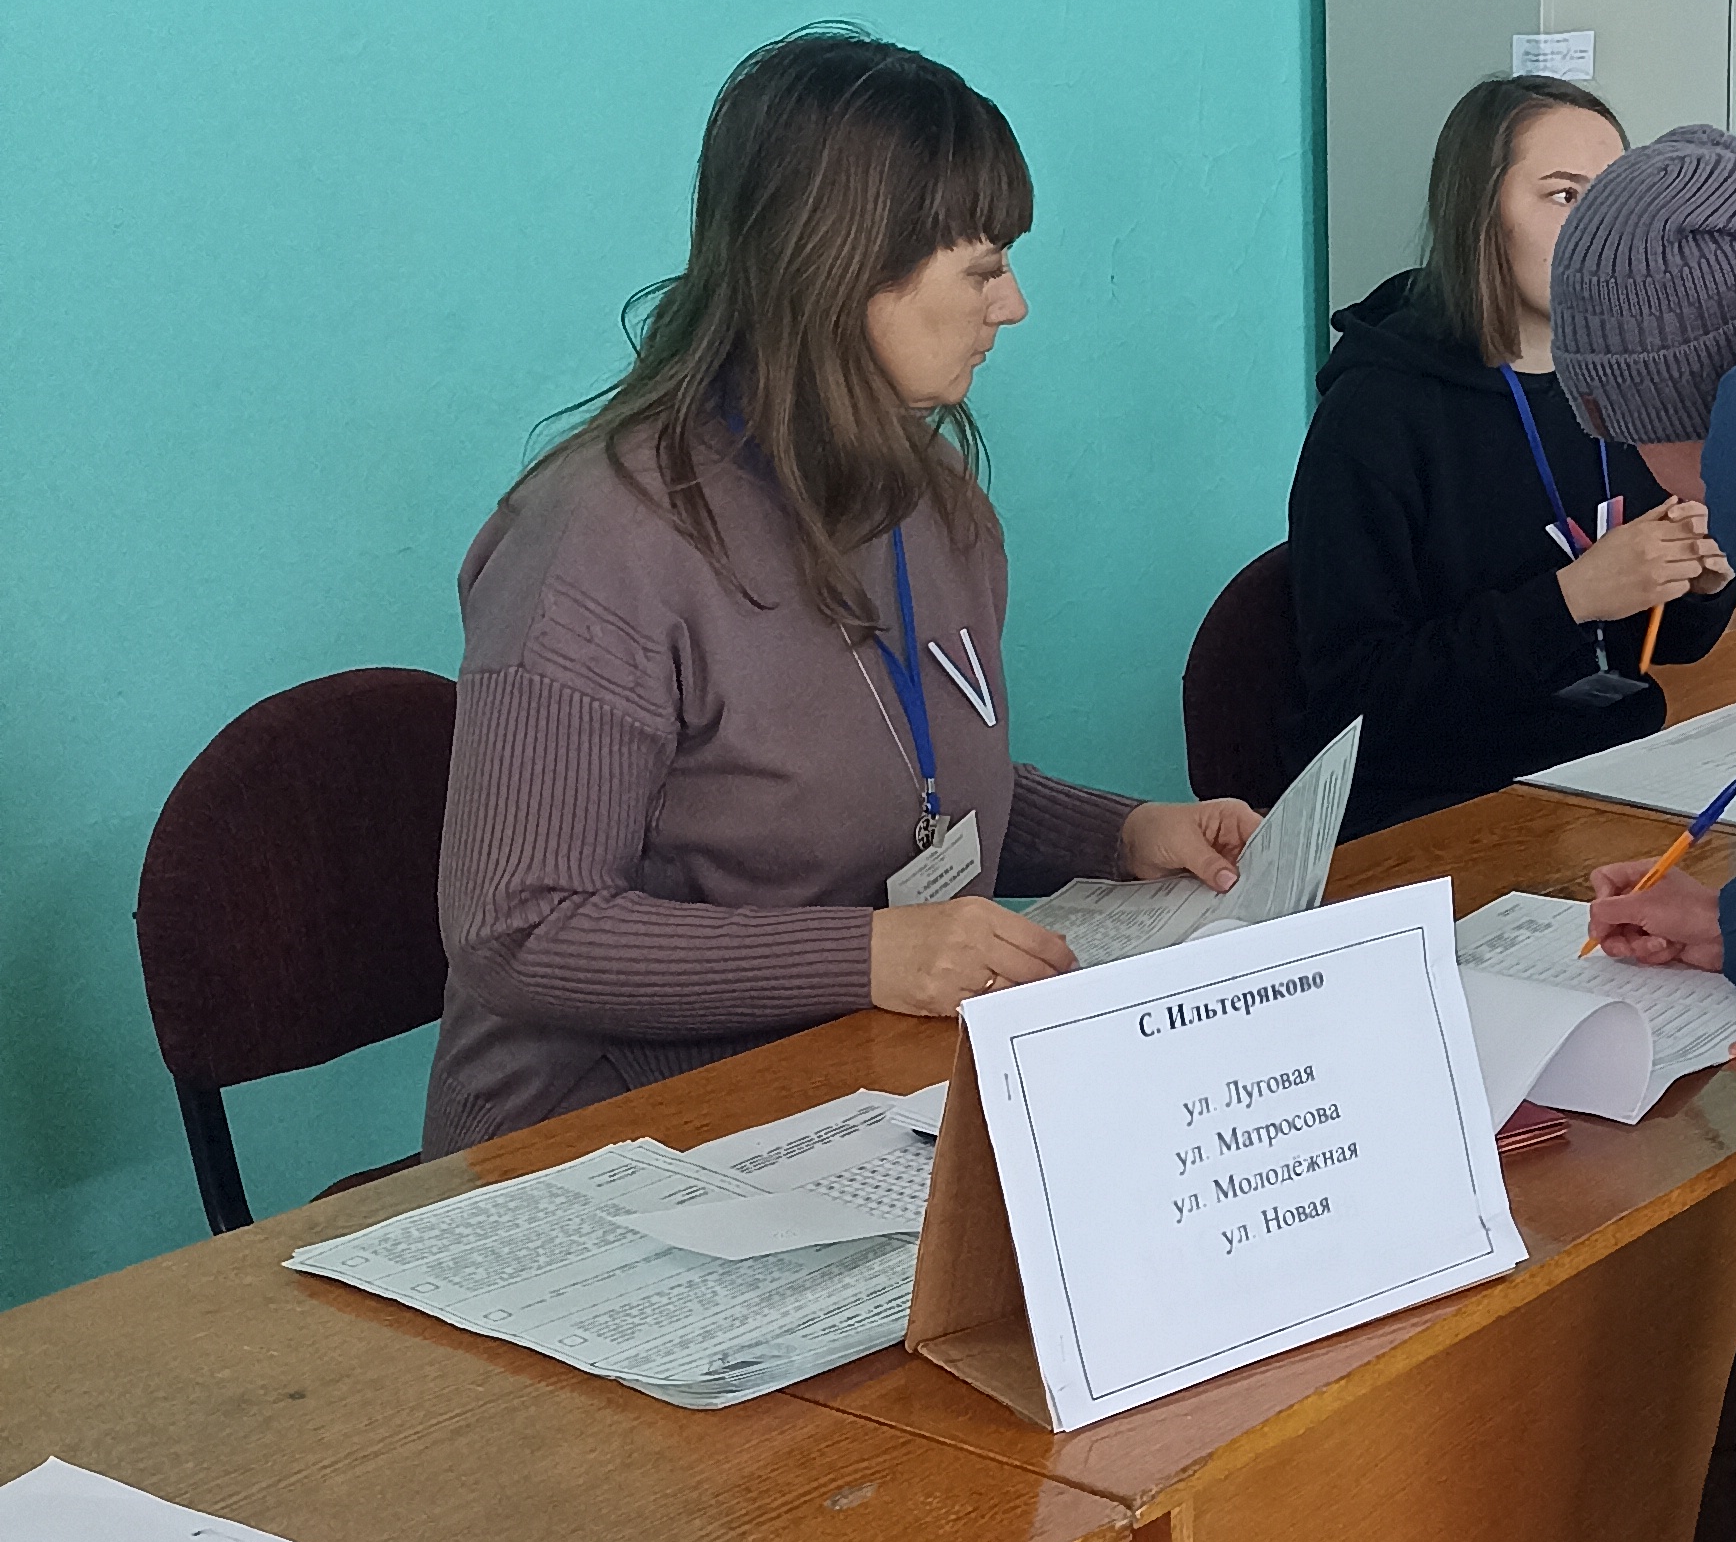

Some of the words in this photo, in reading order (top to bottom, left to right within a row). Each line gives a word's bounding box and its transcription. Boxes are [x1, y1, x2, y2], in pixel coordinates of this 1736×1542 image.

[1138, 1012, 1162, 1038] С.
[1166, 970, 1325, 1031] Ильтеряково
[1182, 1096, 1218, 1128] ул.
[1224, 1064, 1316, 1110] Луговая
[1174, 1145, 1210, 1176] ул.
[1215, 1103, 1342, 1157] Матросова
[1172, 1192, 1207, 1224] ул.
[1212, 1141, 1360, 1204] Молодёжная
[1220, 1223, 1257, 1255] ул.
[1260, 1196, 1332, 1234] Новая
